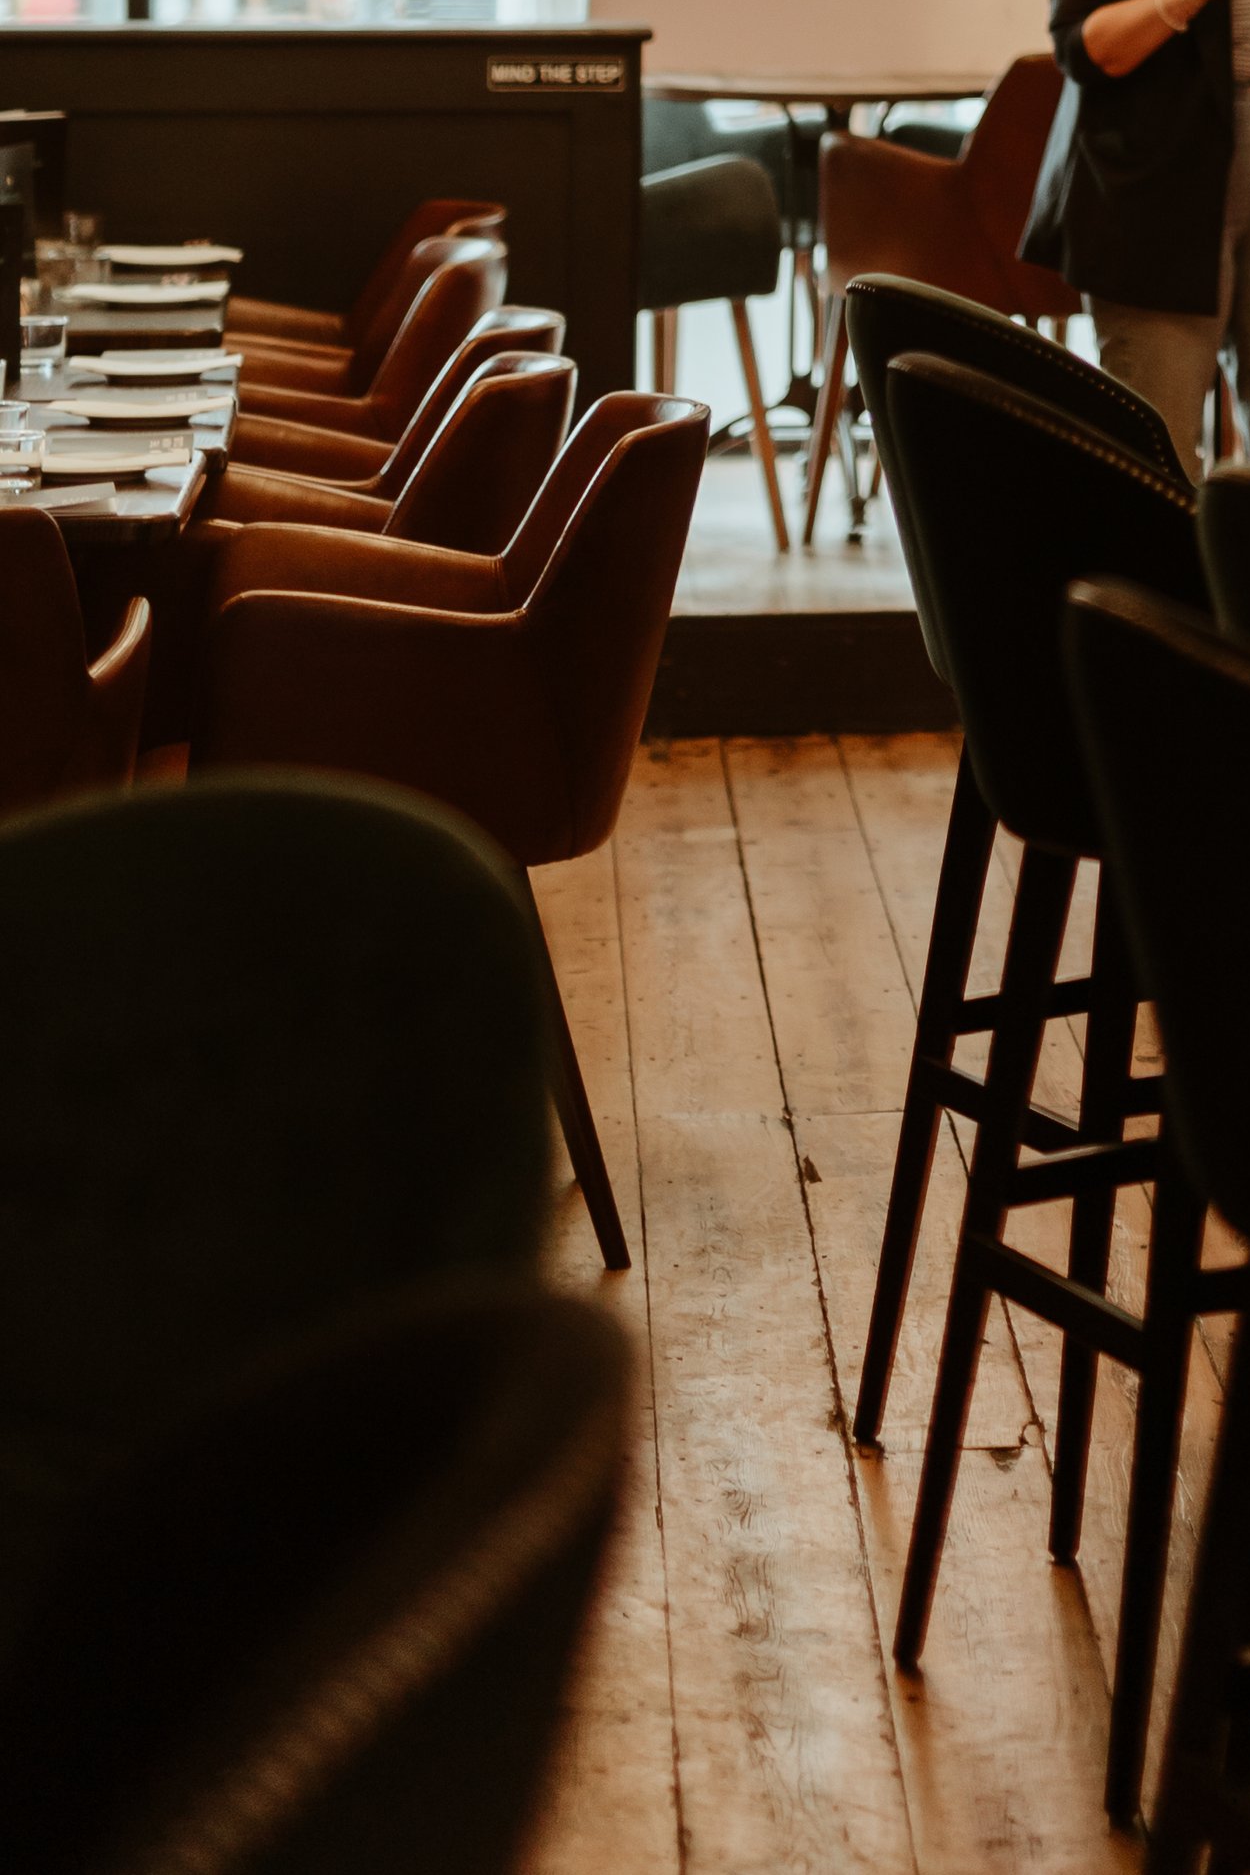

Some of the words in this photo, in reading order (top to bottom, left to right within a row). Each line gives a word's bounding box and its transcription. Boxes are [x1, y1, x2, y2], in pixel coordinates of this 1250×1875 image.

[491, 63, 536, 84] MIND
[540, 63, 573, 84] THE
[575, 63, 619, 84] STEP
